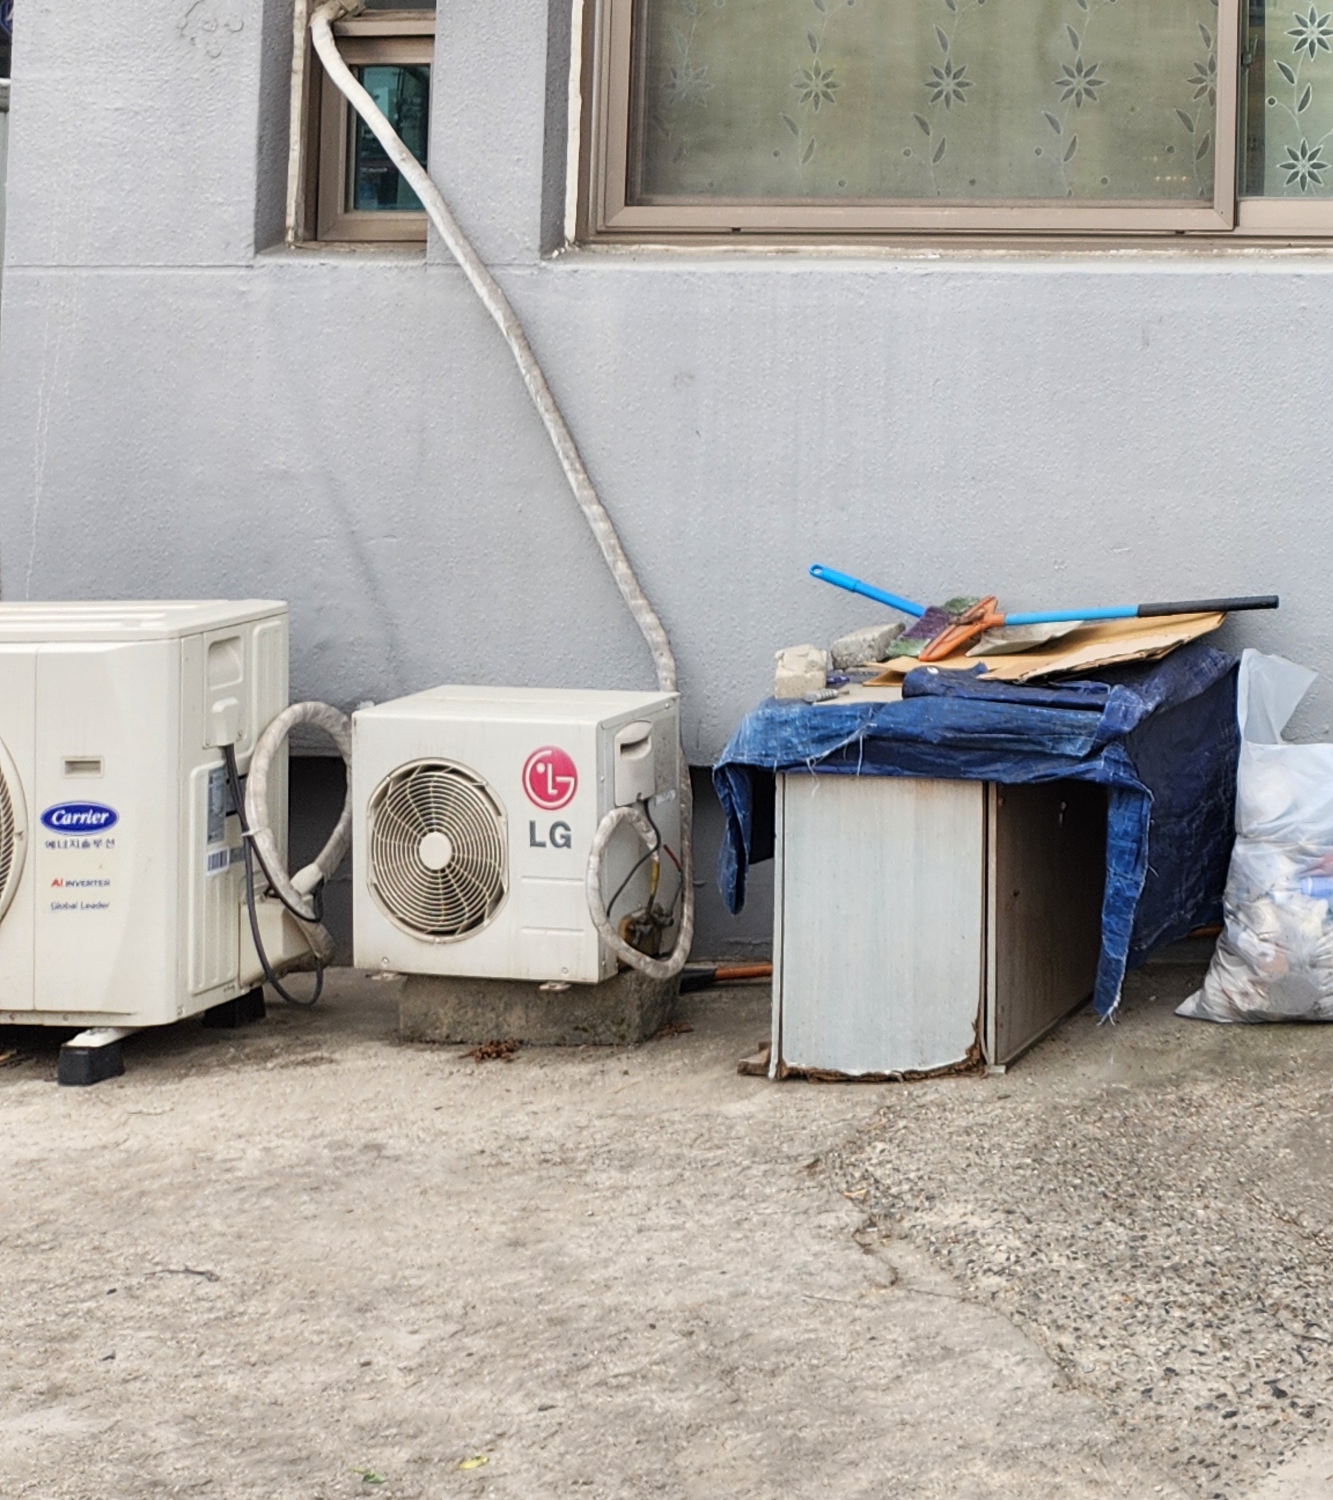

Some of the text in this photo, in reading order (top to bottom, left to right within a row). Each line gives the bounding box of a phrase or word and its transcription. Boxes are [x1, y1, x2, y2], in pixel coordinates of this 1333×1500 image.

[51, 808, 110, 826] Carrier
[528, 820, 573, 850] LG
[65, 878, 111, 888] INVERTER
